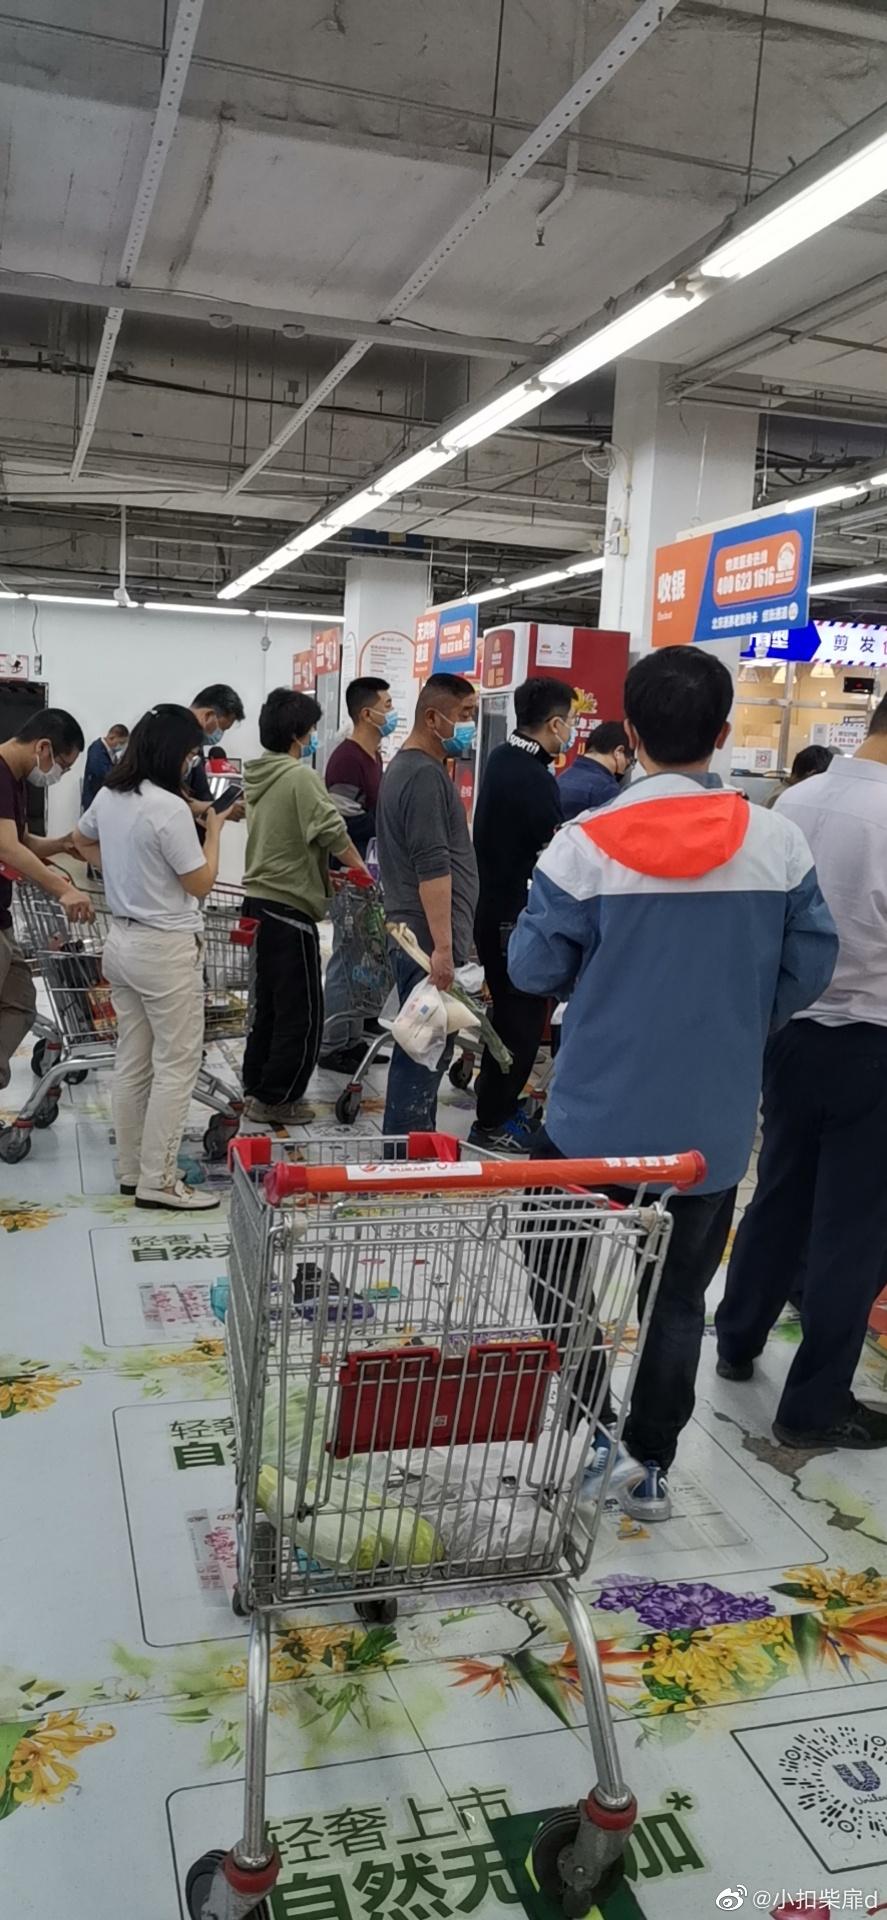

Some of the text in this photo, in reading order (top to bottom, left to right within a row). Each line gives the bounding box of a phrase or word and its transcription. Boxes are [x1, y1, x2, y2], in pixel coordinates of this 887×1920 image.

[657, 569, 687, 604] 收银
[735, 570, 753, 592] 623
[754, 566, 775, 588] 1616
[173, 1437, 237, 1471] 自
